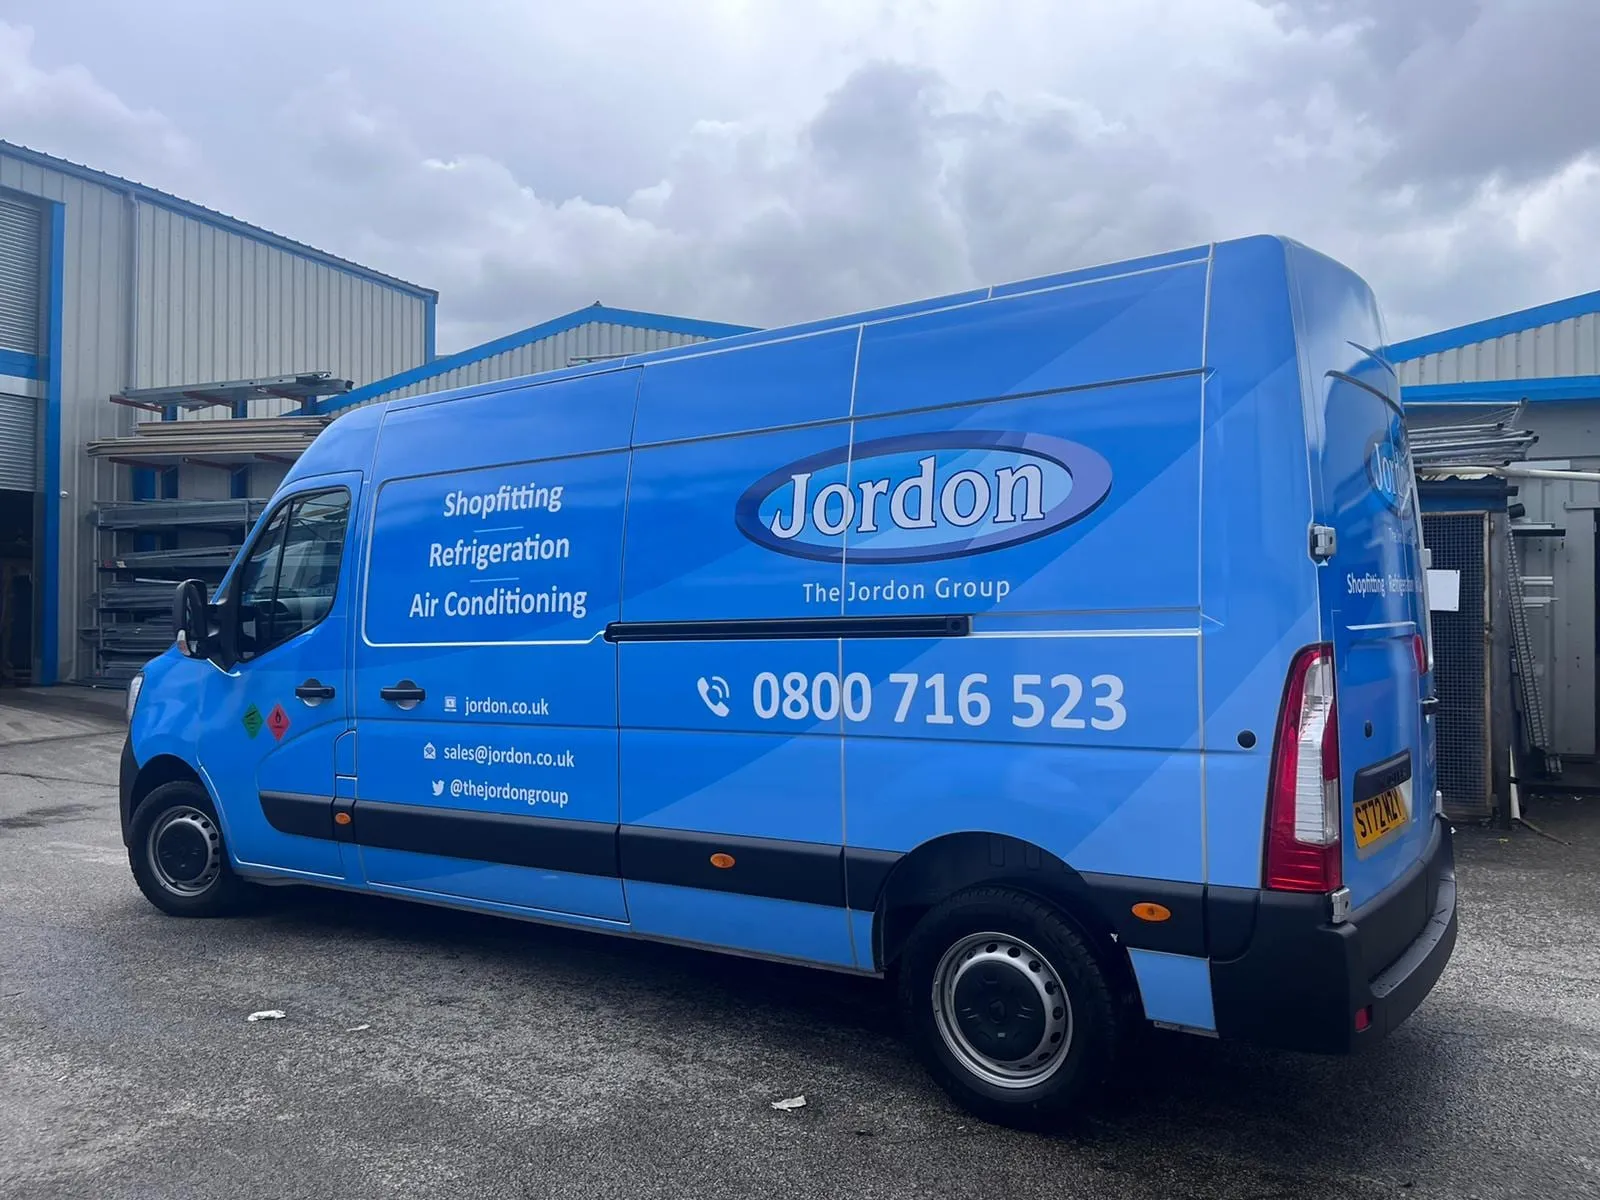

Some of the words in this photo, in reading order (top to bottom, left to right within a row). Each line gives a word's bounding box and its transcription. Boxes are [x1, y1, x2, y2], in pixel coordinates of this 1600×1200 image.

[443, 482, 564, 519] Shopfitting
[768, 455, 1046, 540] Jordon
[429, 533, 570, 570] Refrigeration
[803, 583, 841, 603] The
[847, 579, 925, 602] Jordon
[934, 577, 1010, 602] Group
[1346, 571, 1385, 598] Shopfitting
[409, 591, 439, 618] Air
[444, 585, 588, 619] Conditioning
[464, 696, 549, 716] jordon.co.uk
[752, 671, 872, 721] 0800
[888, 672, 991, 725] 716
[1011, 673, 1127, 731] 523
[443, 743, 575, 768] sales@jordon.co.uk
[450, 778, 569, 808] @thejordongroup
